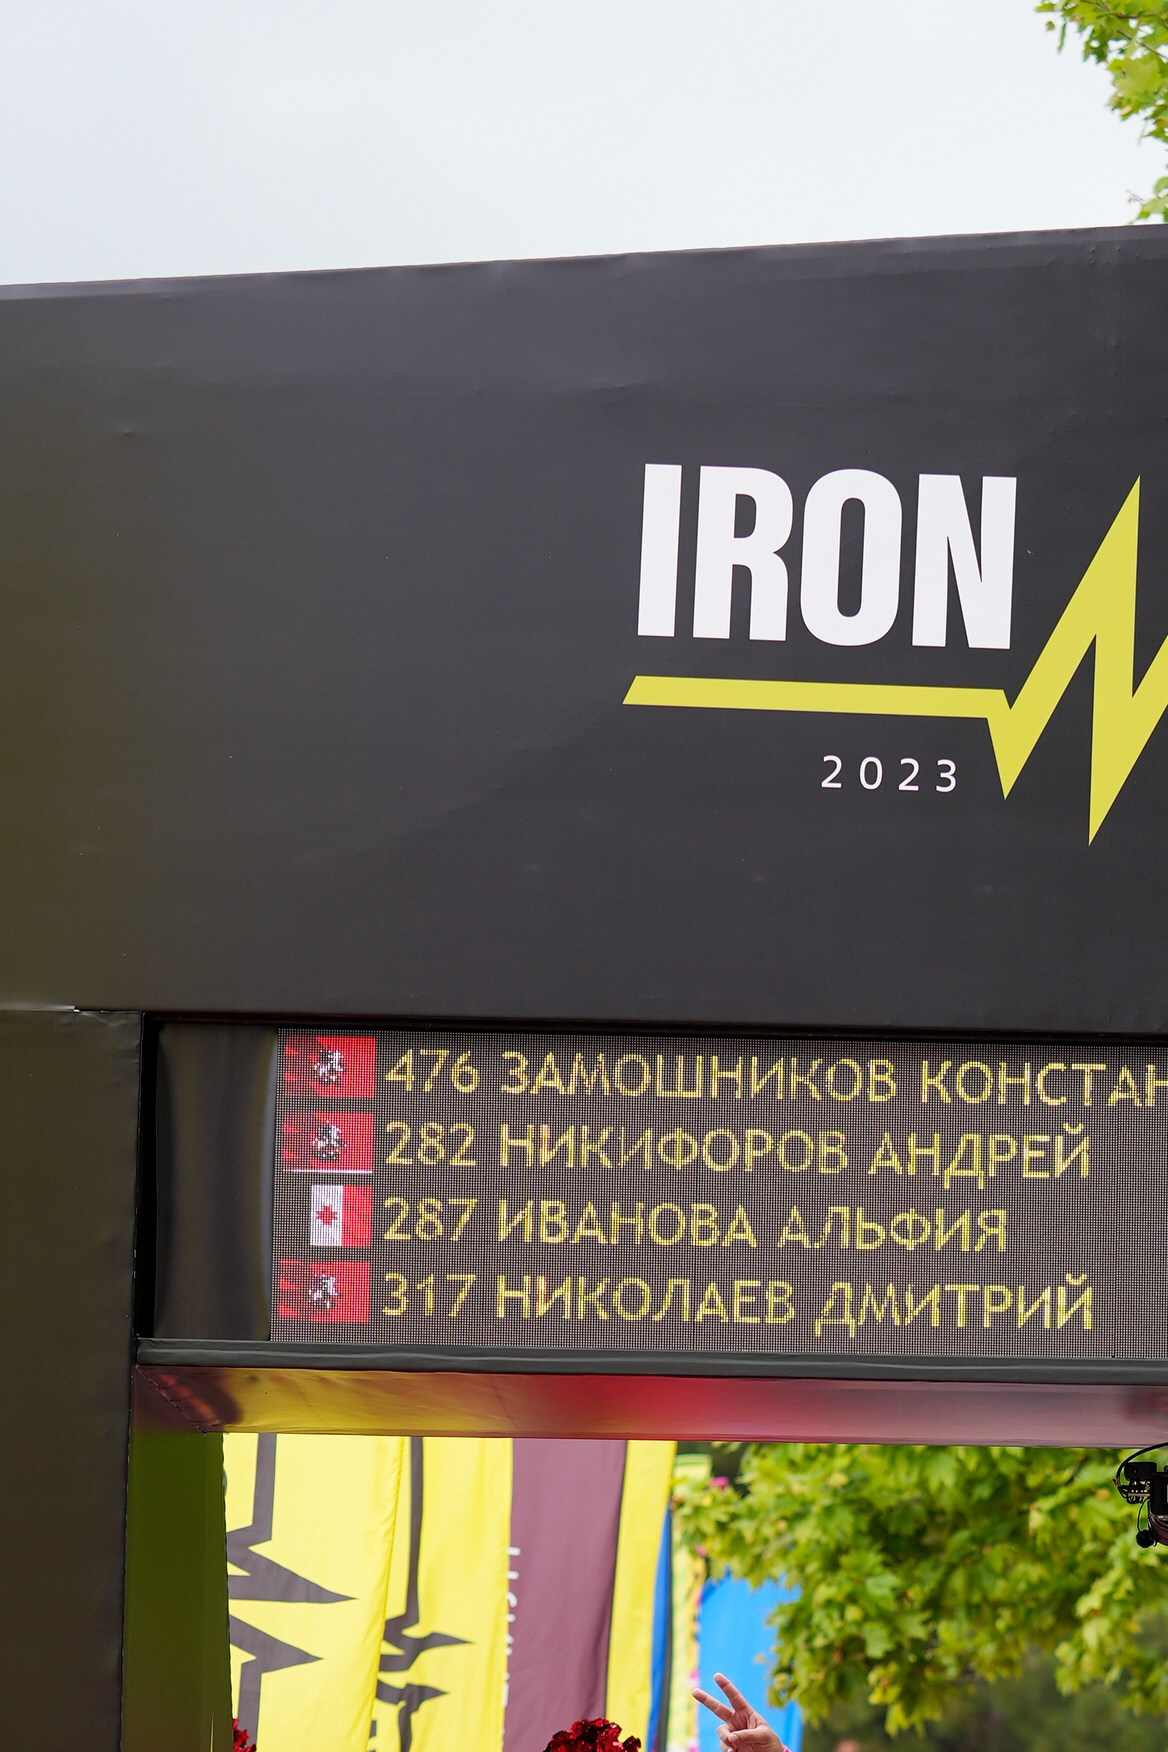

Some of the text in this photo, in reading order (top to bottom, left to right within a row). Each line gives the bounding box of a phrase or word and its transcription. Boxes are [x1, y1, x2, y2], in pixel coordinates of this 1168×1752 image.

[635, 462, 1017, 650] IRON
[820, 754, 959, 794] 2023
[384, 1048, 481, 1094] 476
[500, 1051, 897, 1100] ЗАМОШНИКОВ
[384, 1122, 478, 1168] 282
[501, 1124, 849, 1175] НИКИФОРОВ
[868, 1122, 1092, 1190] АНДРЕЙ
[382, 1198, 479, 1243] 287
[498, 1199, 758, 1249] ИВАНОВА
[780, 1203, 1008, 1254] АЛЬФИЯ
[381, 1272, 477, 1318] 317
[496, 1273, 797, 1326] НИКОЛАЕВ
[814, 1272, 1094, 1340] ДМИТРИЙ
